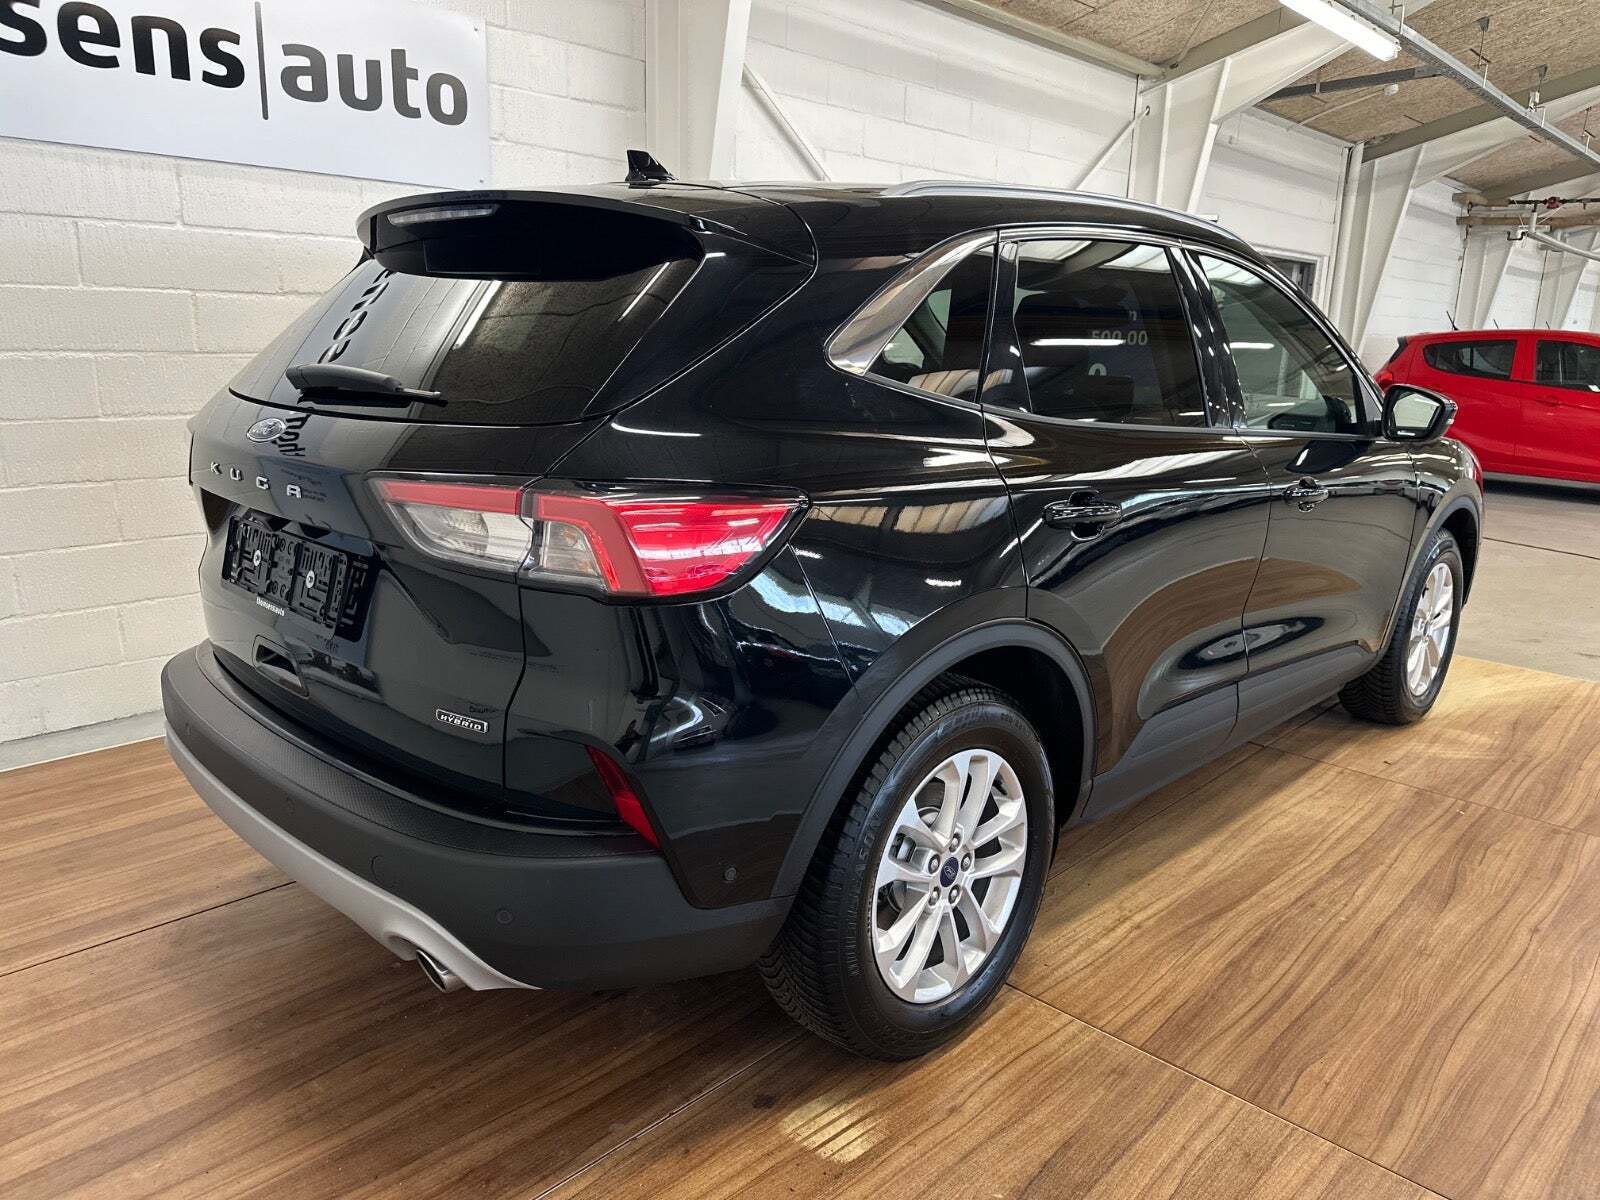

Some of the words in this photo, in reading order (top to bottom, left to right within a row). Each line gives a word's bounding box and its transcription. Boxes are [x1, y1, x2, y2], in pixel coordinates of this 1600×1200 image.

[280, 43, 468, 126] auto
[210, 461, 302, 498] KUGA
[440, 713, 482, 730] HYBRID
